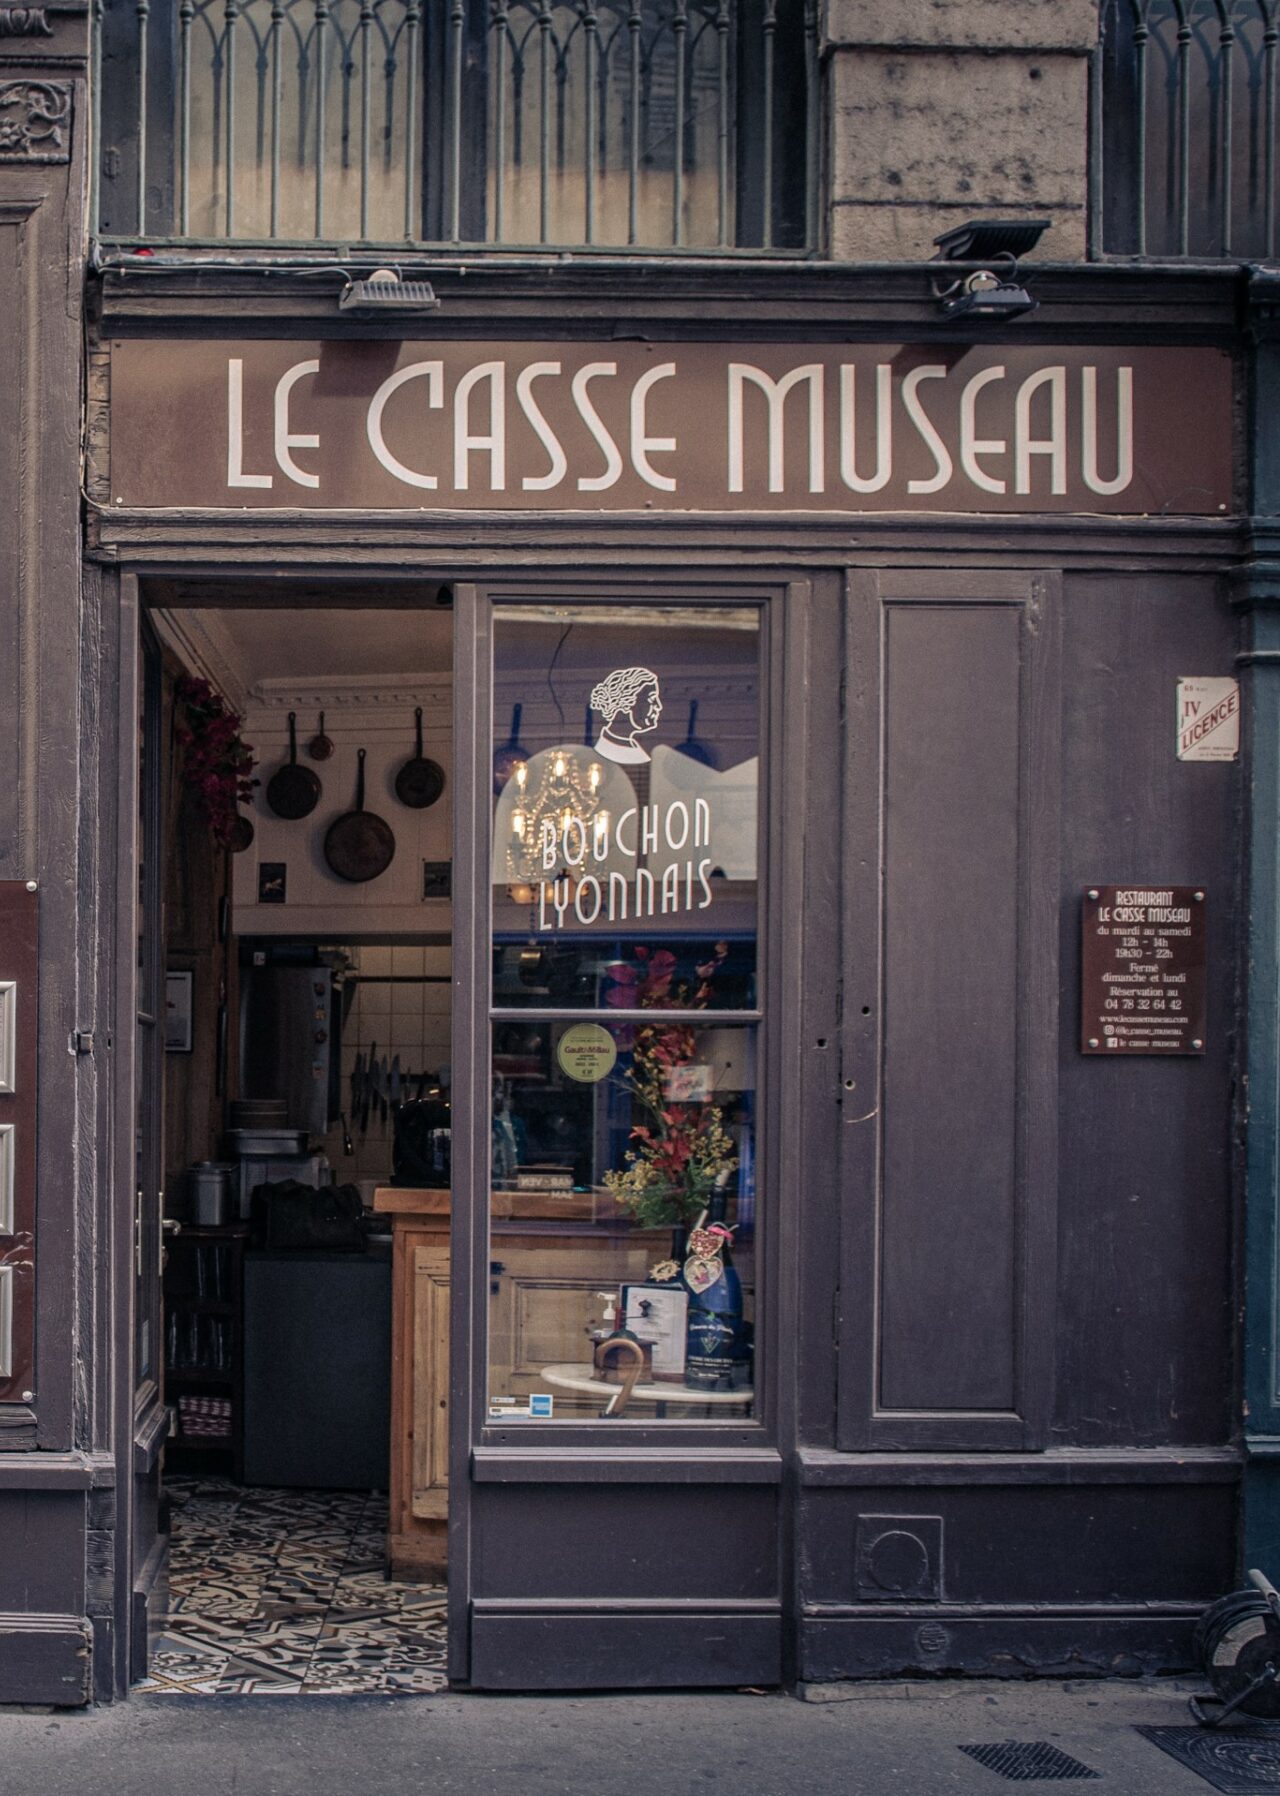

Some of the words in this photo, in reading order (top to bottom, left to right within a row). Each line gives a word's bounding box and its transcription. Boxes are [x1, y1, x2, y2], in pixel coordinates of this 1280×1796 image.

[227, 358, 320, 489] LE
[367, 360, 677, 491] CASSE
[727, 363, 1133, 495] MUSEAU
[1184, 700, 1201, 717] IV
[1182, 695, 1235, 749] LICENCE
[542, 798, 710, 870] BOUCHON
[539, 858, 712, 931] LYONNAIS
[1116, 890, 1174, 906] RESTAURANT
[1098, 907, 1111, 922] LE
[1113, 907, 1145, 922] CASSE
[1147, 907, 1191, 923] MUSEAU
[1097, 926, 1109, 935] du
[1112, 926, 1140, 936] mardi
[1143, 928, 1155, 936] au
[1158, 926, 1191, 936] samedi
[1122, 937, 1139, 947] 12h
[1153, 938, 1169, 947] 14h
[1115, 948, 1142, 958] 19h30
[1155, 949, 1173, 959] 22h
[1129, 962, 1159, 973] Fermé
[1102, 972, 1147, 982] dimanche
[1150, 974, 1160, 982] et
[1163, 973, 1186, 983] lundi
[1110, 986, 1163, 996] Réservation
[1167, 989, 1178, 997] au
[1104, 999, 1118, 1010] 04
[1122, 999, 1134, 1010] 78
[1137, 999, 1150, 1010] 32
[1153, 999, 1166, 1010] 64
[1169, 999, 1182, 1010] 42
